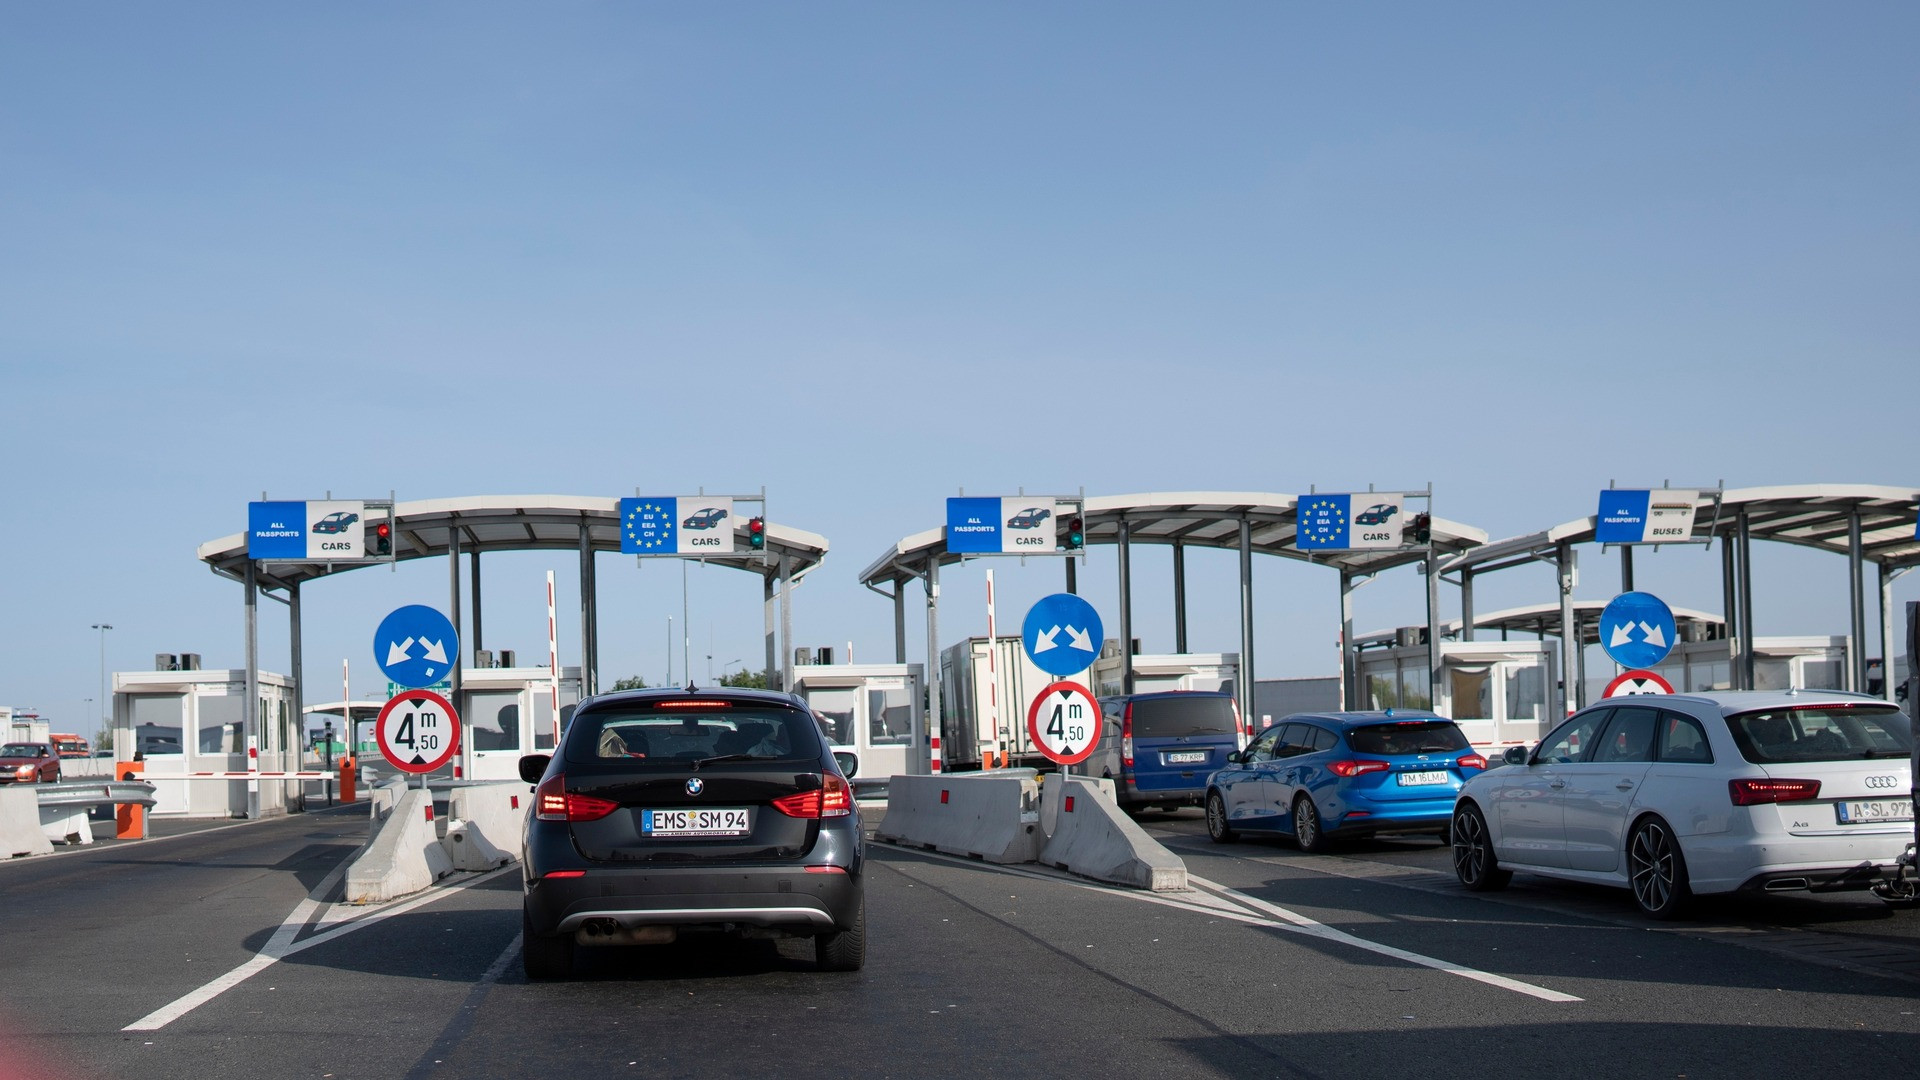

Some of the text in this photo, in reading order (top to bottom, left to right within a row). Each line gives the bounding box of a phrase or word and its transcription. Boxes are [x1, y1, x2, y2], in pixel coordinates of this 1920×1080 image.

[1016, 537, 1044, 545] CARS
[1363, 533, 1390, 541] CARS
[321, 542, 351, 550] CARS
[691, 538, 720, 546] CARS
[1403, 774, 1417, 783] TM
[1854, 804, 1863, 817] A
[1871, 803, 1889, 817] SL
[653, 812, 687, 829] EMS
[699, 812, 721, 828] SM
[725, 812, 746, 828] 94
